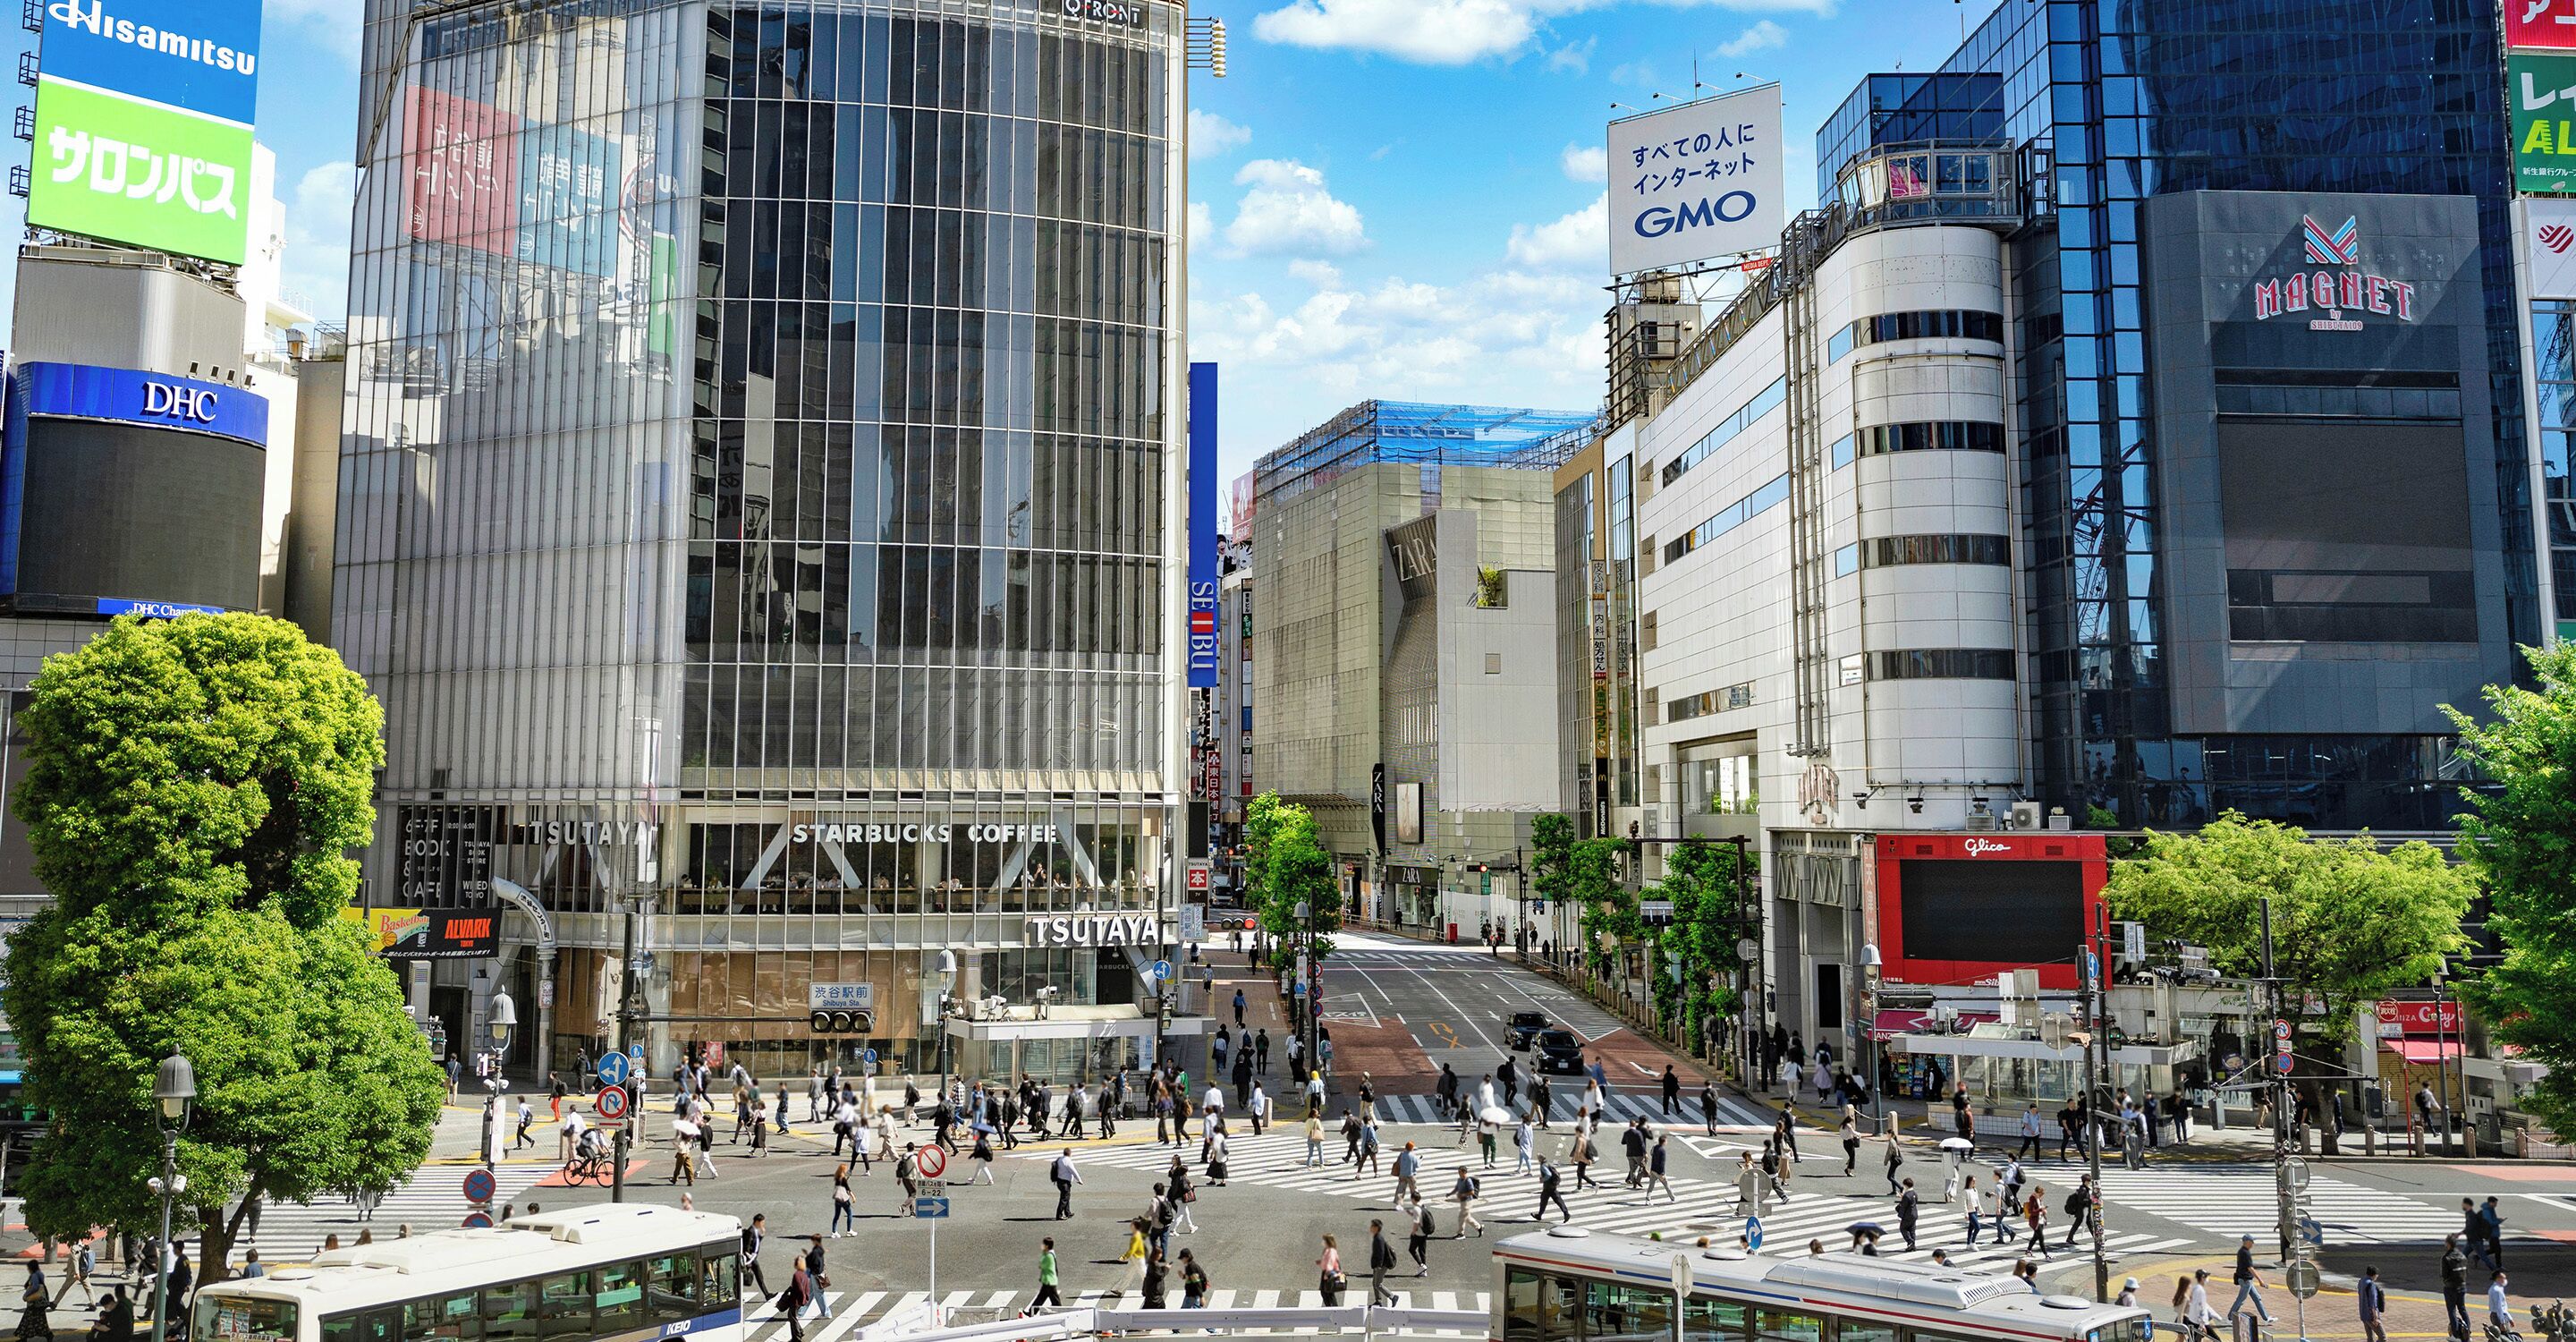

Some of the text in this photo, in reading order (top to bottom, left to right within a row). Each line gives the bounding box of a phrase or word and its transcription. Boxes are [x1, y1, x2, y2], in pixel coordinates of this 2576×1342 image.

[48, 0, 255, 75] Hisamitsu
[1632, 124, 1755, 168] すべての人に
[48, 125, 236, 221] サロンパス
[1633, 152, 1755, 195] インターネット
[1634, 191, 1757, 238] GMO
[2255, 271, 2415, 321] MAGNET
[2310, 320, 2363, 331] SHIBUYA109
[2329, 309, 2342, 320] by
[144, 381, 218, 421] DHC
[1594, 562, 1604, 593] 皮ふ科
[133, 602, 159, 616] DHC
[1191, 581, 1214, 670] SEIBU
[1595, 614, 1605, 635] 内科
[1595, 641, 1606, 671] 処方せん
[1373, 771, 1383, 813] ZARA
[530, 821, 648, 845] TSUTAYA
[792, 824, 1056, 843] STARBUCKS COFFEE
[1964, 837, 2011, 854] Glico
[1191, 871, 1205, 886] 本
[1402, 867, 1420, 883] ZARA
[445, 918, 492, 939] ALVARK
[1032, 915, 1158, 946] TSUTAYA
[815, 986, 868, 998] 渋谷駅前
[823, 999, 847, 1007] Shibuya
[2221, 1091, 2252, 1106] MART
[666, 1320, 691, 1335] KEIO
